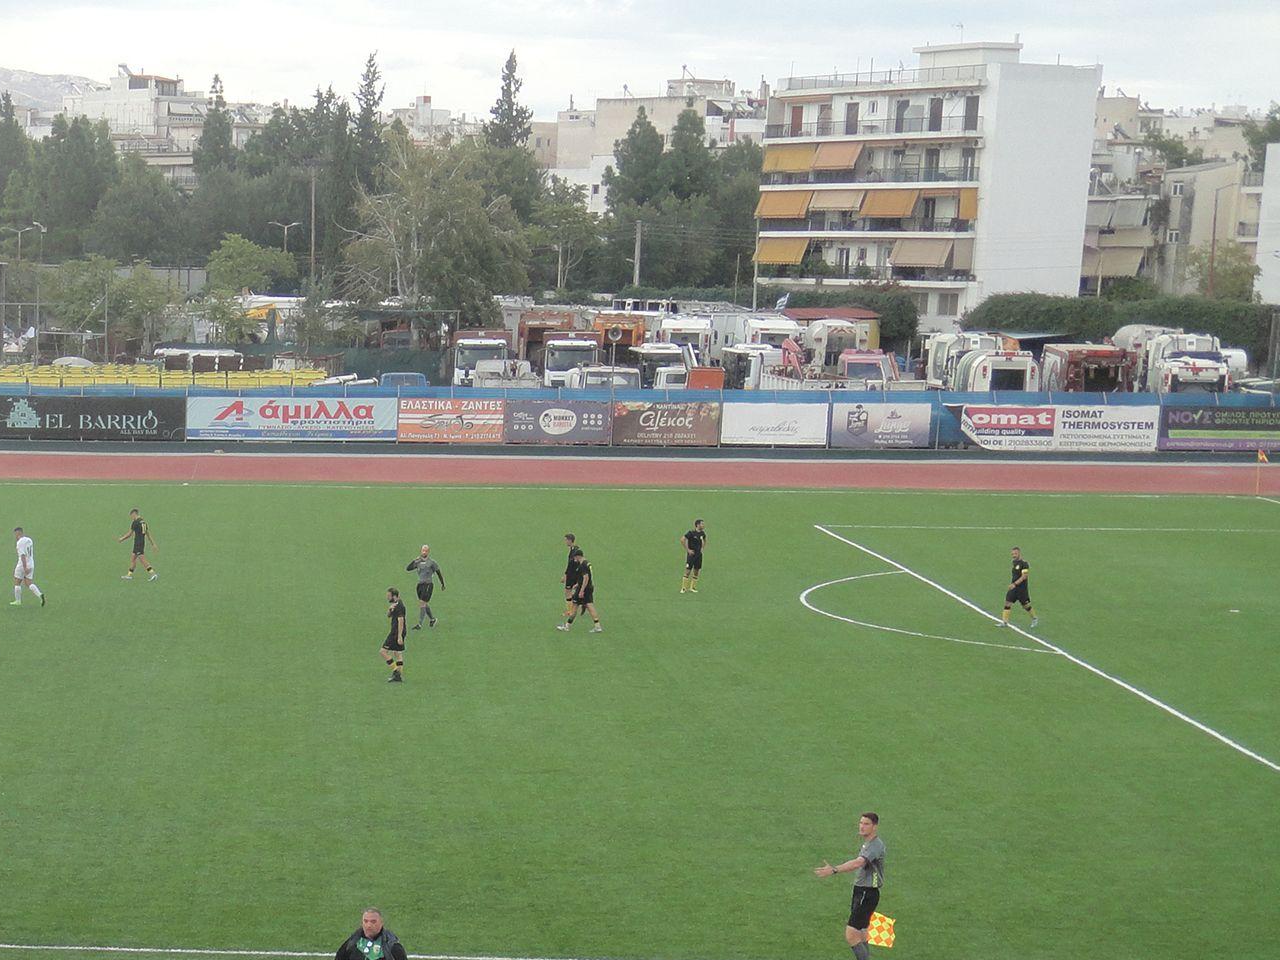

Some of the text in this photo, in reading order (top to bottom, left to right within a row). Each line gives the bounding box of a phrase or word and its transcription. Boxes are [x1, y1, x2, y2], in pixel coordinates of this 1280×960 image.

[400, 400, 503, 410] ΕΛΑΣΤΙΚΑ ΖΑΝΤΕΣ
[258, 399, 375, 424] άμιλλα
[1062, 410, 1105, 419] ISOMAT
[45, 410, 159, 430] EL BARRIO
[972, 411, 1052, 425] omat
[1061, 421, 1154, 430] THERMOSYSTEM
[976, 428, 1000, 436] uilding
